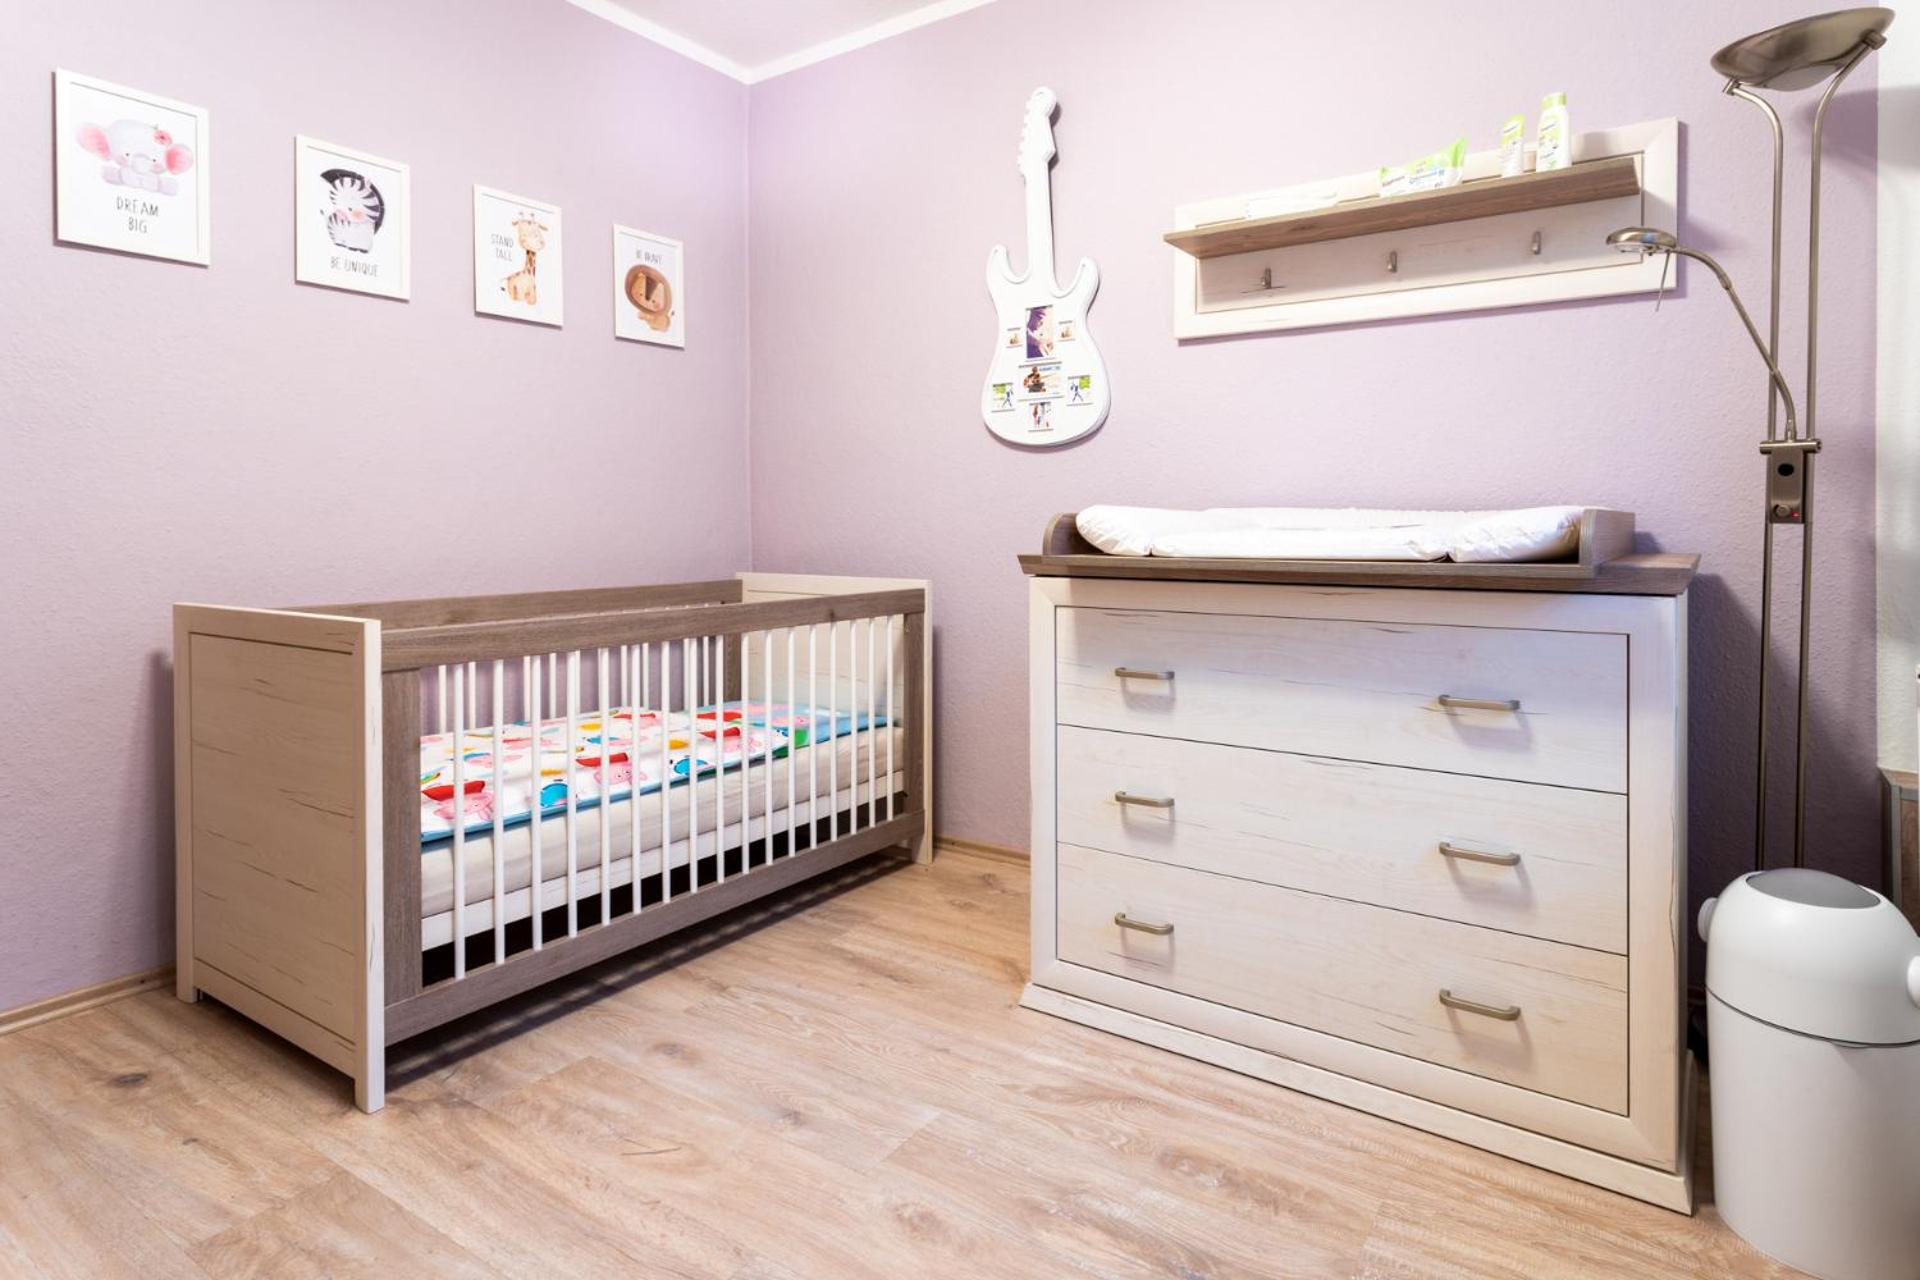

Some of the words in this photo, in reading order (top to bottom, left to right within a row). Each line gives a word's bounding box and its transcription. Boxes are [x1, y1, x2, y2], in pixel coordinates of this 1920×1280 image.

[116, 196, 159, 217] DREAM
[128, 217, 148, 234] BIG
[491, 233, 514, 248] STAND
[496, 247, 513, 262] TALL
[330, 256, 342, 269] BE
[344, 258, 378, 278] UNIQUE
